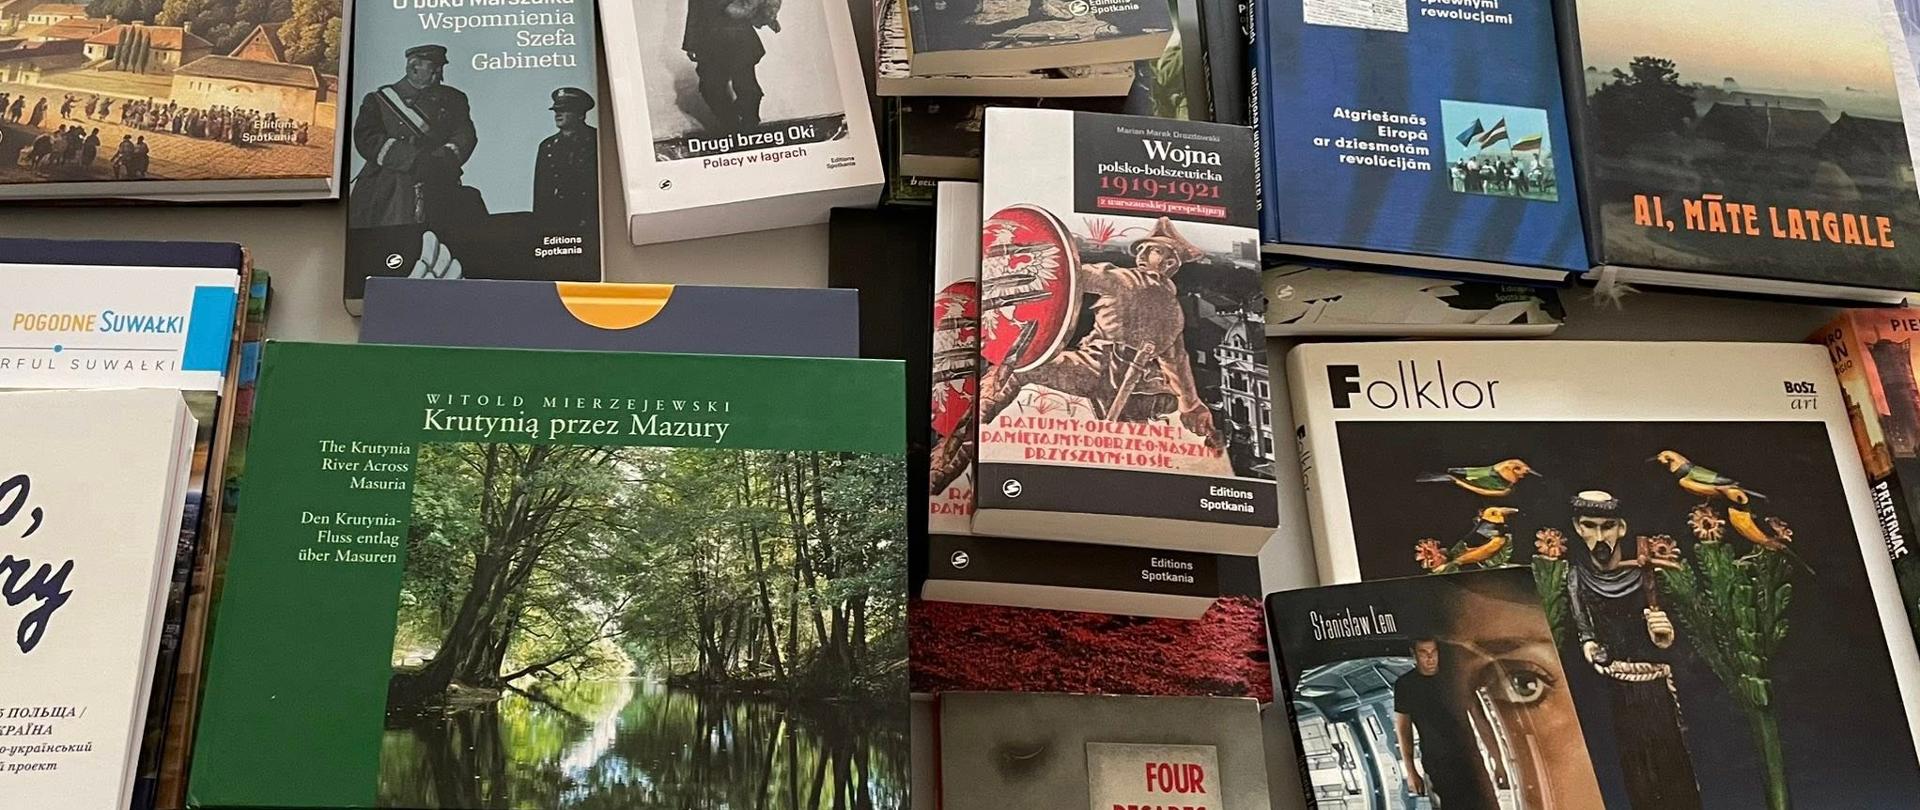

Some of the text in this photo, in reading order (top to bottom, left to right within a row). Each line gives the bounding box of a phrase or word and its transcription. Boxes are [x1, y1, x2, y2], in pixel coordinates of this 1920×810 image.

[1090, 3, 1139, 15] Spotkania
[1421, 8, 1513, 24] rewolucjami
[418, 9, 576, 32] Wspomnienia
[516, 29, 576, 47] Szefa
[471, 52, 577, 71] Gabinetu
[253, 120, 297, 129] Editions
[1333, 106, 1427, 126] Atgriešanās
[688, 125, 815, 153] Drugi brzeg Oki
[1117, 126, 1145, 135] Marian
[1146, 129, 1172, 138] Marek
[1377, 125, 1429, 141] Eiropā
[1142, 139, 1222, 168] Wojna
[1313, 136, 1429, 155] ar dziesmotām
[703, 147, 807, 169] Polacy w łagrach
[1339, 154, 1431, 171] revolūcijām
[1098, 161, 1223, 181] polsko-bolszewicka
[1100, 176, 1220, 201] 1919-1921
[1633, 193, 1895, 248] AI, MĀTE LATGALE
[543, 235, 582, 245] Editions
[534, 246, 583, 258] Spotkania
[13, 313, 97, 332] POGODNE
[71, 359, 176, 371] SUWAŁKI
[1326, 360, 1500, 409] Folklor
[426, 393, 731, 413] WITOLD MIERZEJEWSKI
[423, 408, 730, 443] Krutynią przez Mazury
[319, 440, 411, 457] The Krutynia
[322, 458, 409, 473] River Across
[350, 476, 406, 490] Masuria
[1209, 485, 1254, 500] Editions
[1200, 498, 1255, 513] Spotkania
[301, 511, 402, 529] Den Krutynia-
[317, 530, 401, 548] Fluss entlag
[298, 547, 397, 563] über Masuren
[1151, 557, 1194, 570] Editions
[1141, 569, 1194, 583] Spotkania
[1369, 605, 1397, 634] Lem
[7, 706, 76, 719] ПОЛЬЩА
[1145, 762, 1207, 793] FOUR
